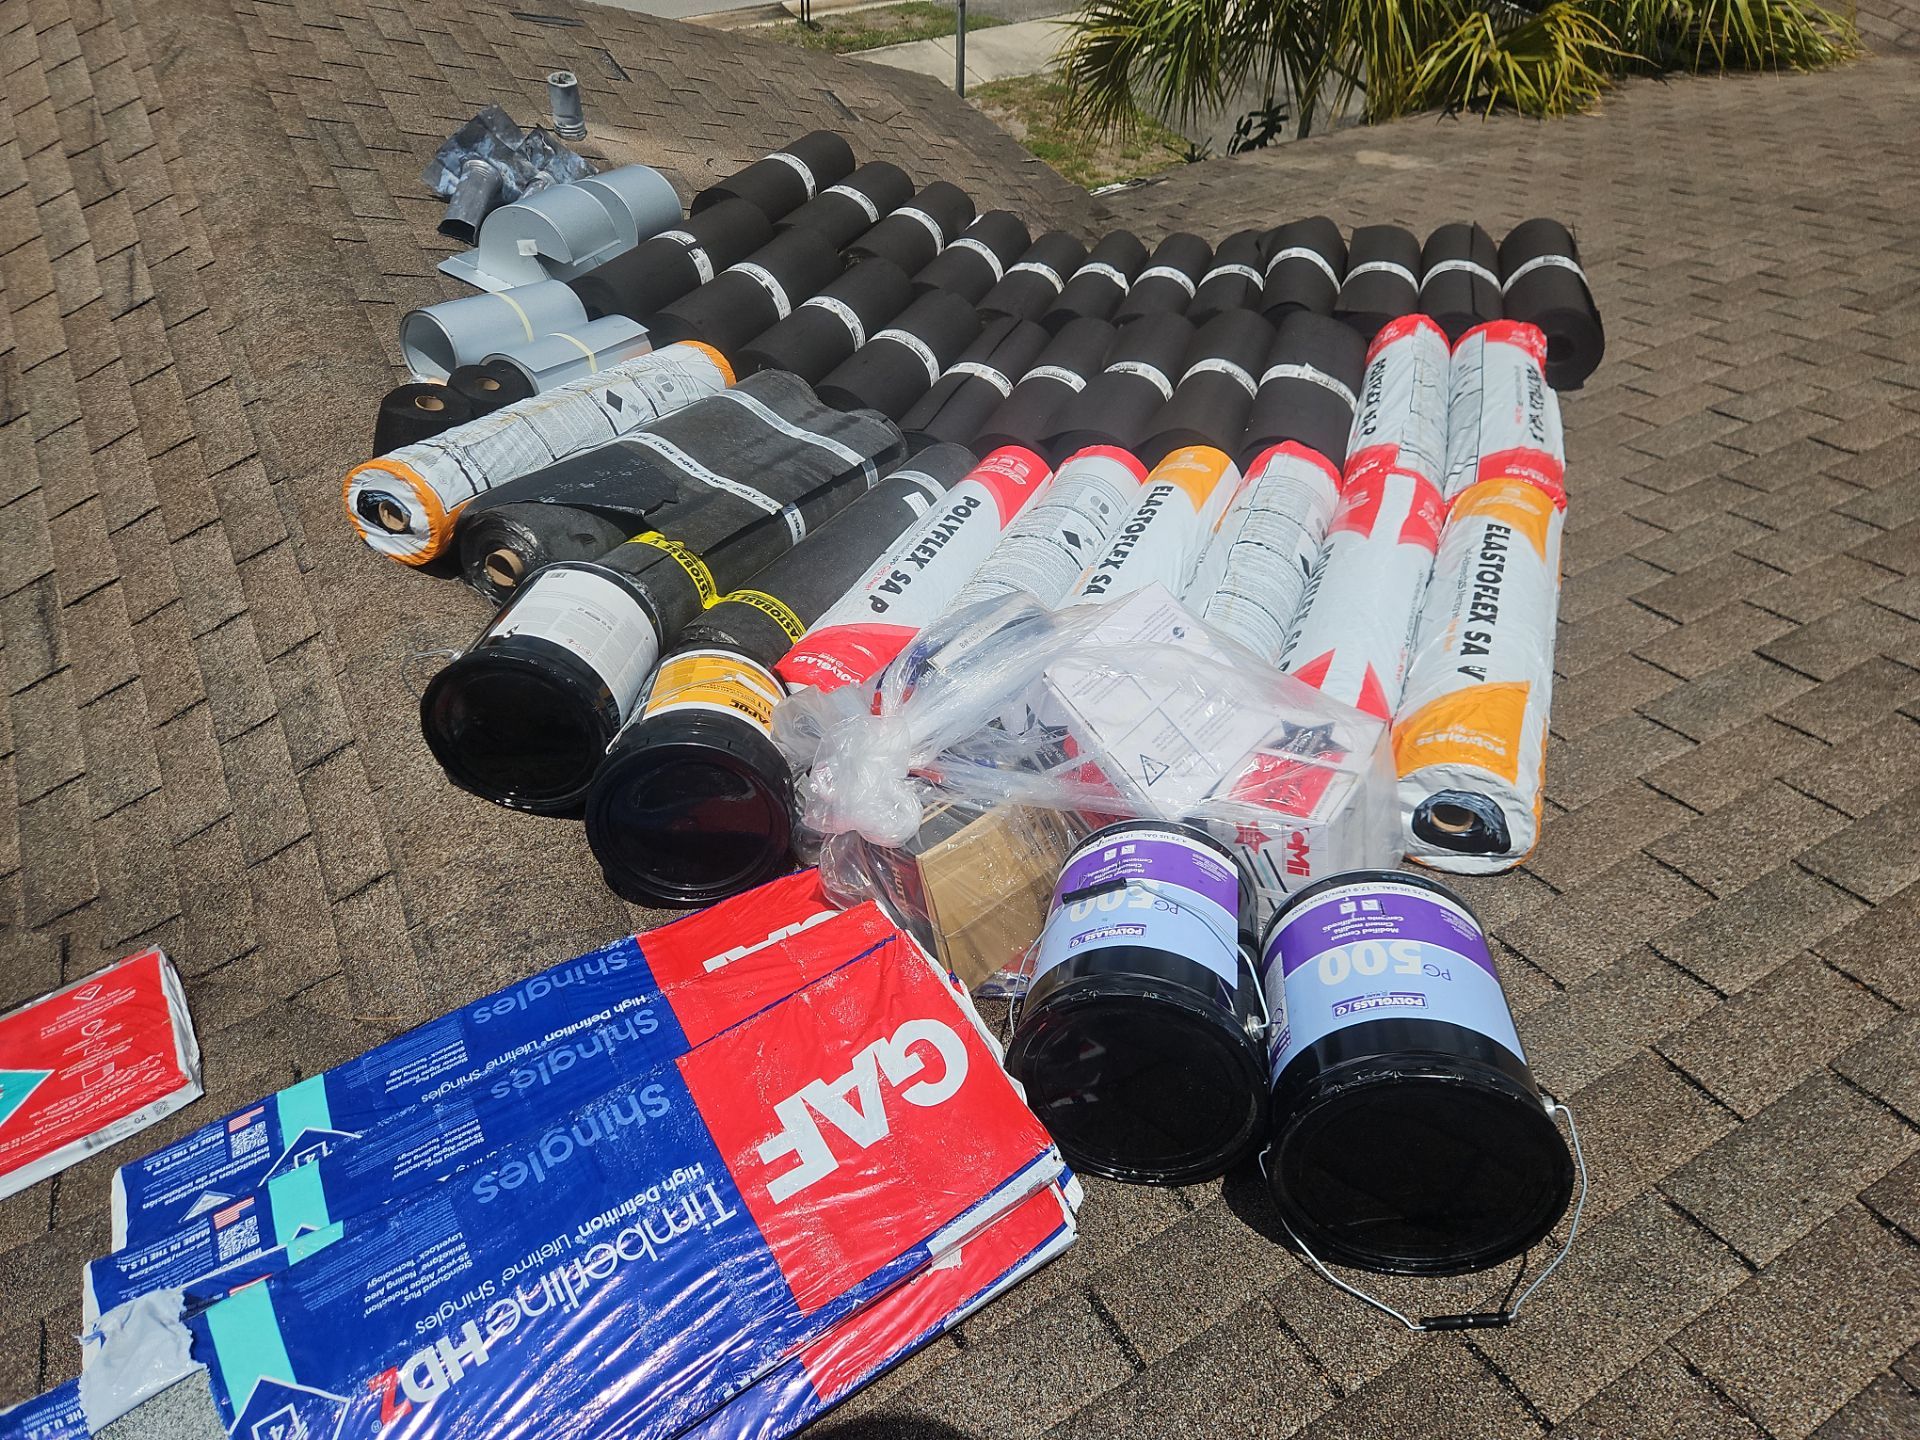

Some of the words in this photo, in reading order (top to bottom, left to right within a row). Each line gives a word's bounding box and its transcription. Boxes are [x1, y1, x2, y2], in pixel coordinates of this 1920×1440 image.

[906, 485, 979, 568] POLYFLEX
[1099, 473, 1172, 568] ELASTOFLEX
[878, 570, 911, 594] SA
[1081, 574, 1111, 595] SA
[1469, 524, 1509, 623] ELASTOFLEX
[868, 594, 888, 613] P
[1460, 631, 1491, 655] SA
[1152, 899, 1179, 914] PG
[1083, 922, 1143, 945] POLYGLASS
[1330, 930, 1359, 942] Cement
[1361, 925, 1398, 935] Modified
[1317, 936, 1423, 990] 500
[1422, 963, 1451, 981] PG
[473, 942, 626, 1022] Shingles
[613, 995, 646, 1012] High
[1352, 993, 1423, 1013] POLYGLASS
[492, 1010, 657, 1097] Shingles
[421, 1069, 481, 1102] Shingles
[760, 1018, 969, 1205] GAF
[189, 1143, 198, 1151] IN
[201, 1131, 224, 1144] MADE
[474, 1083, 670, 1201] Shingles
[171, 1149, 187, 1159] THE
[397, 1137, 439, 1161] Technology
[143, 1156, 169, 1171] U.S.A.
[209, 1146, 269, 1176] Instrucciones
[219, 1152, 269, 1178] Installation
[393, 1158, 411, 1170] Area
[195, 1175, 207, 1183] de
[662, 1162, 704, 1190] High
[142, 1181, 195, 1208] instalación
[164, 1177, 216, 1205] instructions
[170, 1242, 180, 1251] IN
[183, 1227, 210, 1245] MADE
[116, 1253, 147, 1271] U.S.A.
[150, 1248, 167, 1260] THE
[437, 1251, 469, 1274] 25-year
[367, 1259, 415, 1289] Technology
[386, 1270, 416, 1289] Nailing
[409, 1271, 434, 1288] Algae
[419, 1259, 472, 1293] StainGuard
[364, 1286, 384, 1302] Area
[415, 1280, 494, 1333] Shingles
[24, 1418, 63, 1439] U.S.A.
